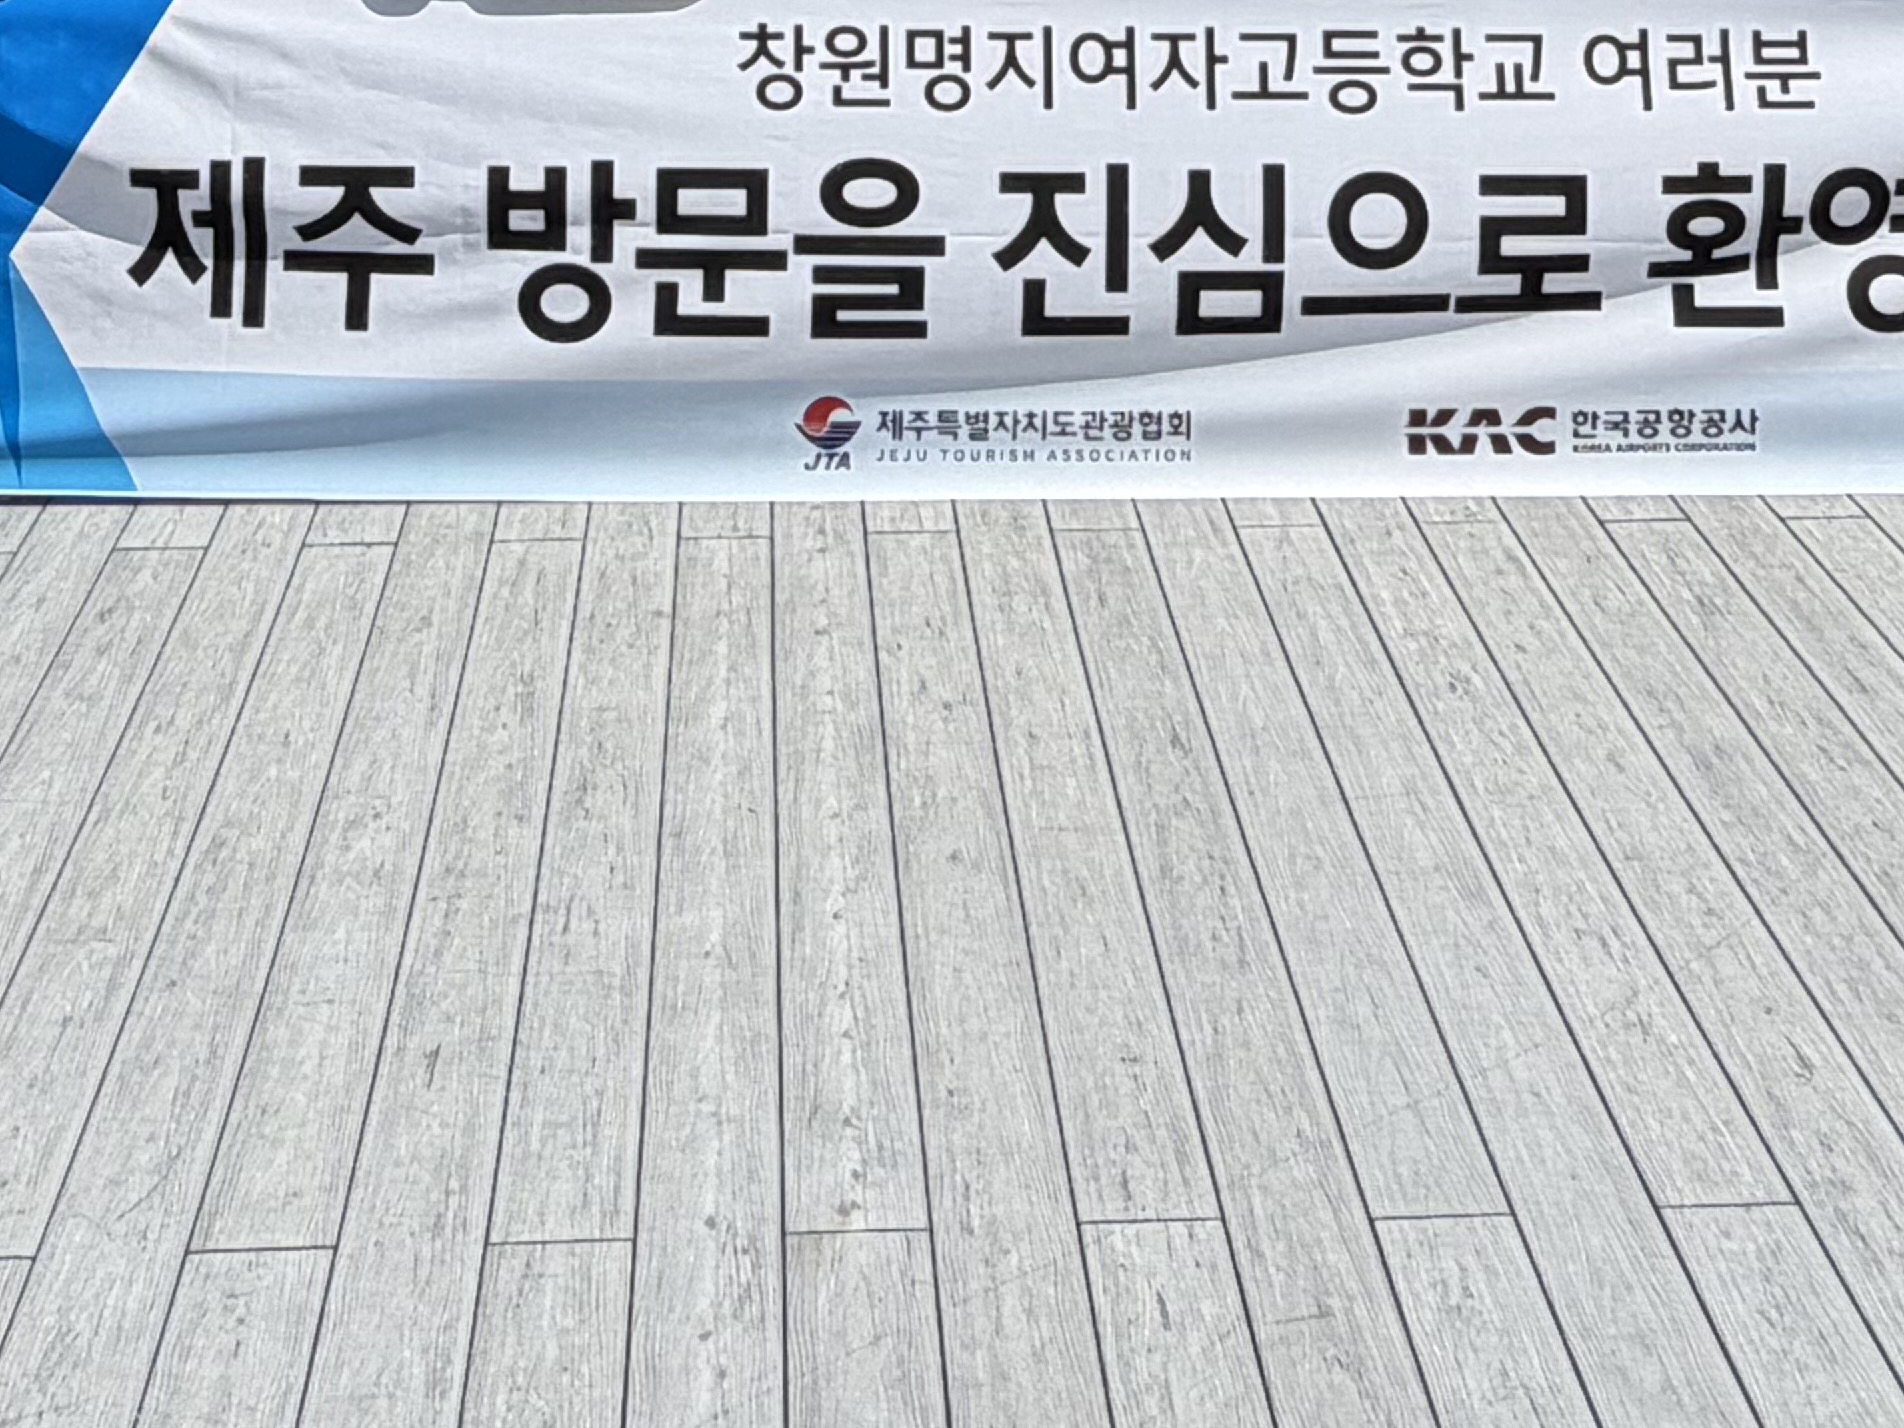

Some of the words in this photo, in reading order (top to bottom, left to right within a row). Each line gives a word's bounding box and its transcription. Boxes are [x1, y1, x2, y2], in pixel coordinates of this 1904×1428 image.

[737, 23, 1556, 115] 창원명지여자고등학교
[1583, 27, 1822, 113] 여러분
[127, 156, 436, 332] 제주
[485, 157, 946, 344] 방문을
[993, 162, 1603, 337] 진심으로
[875, 409, 1193, 443] 제주특별자치도관광협회
[1405, 406, 1558, 457] KAC
[1571, 407, 1761, 441] 한국공항공사
[803, 451, 852, 471] JTA
[875, 448, 928, 463] JEJU
[940, 448, 1036, 463] TOURISM
[1046, 448, 1193, 463] ASSOCIATION
